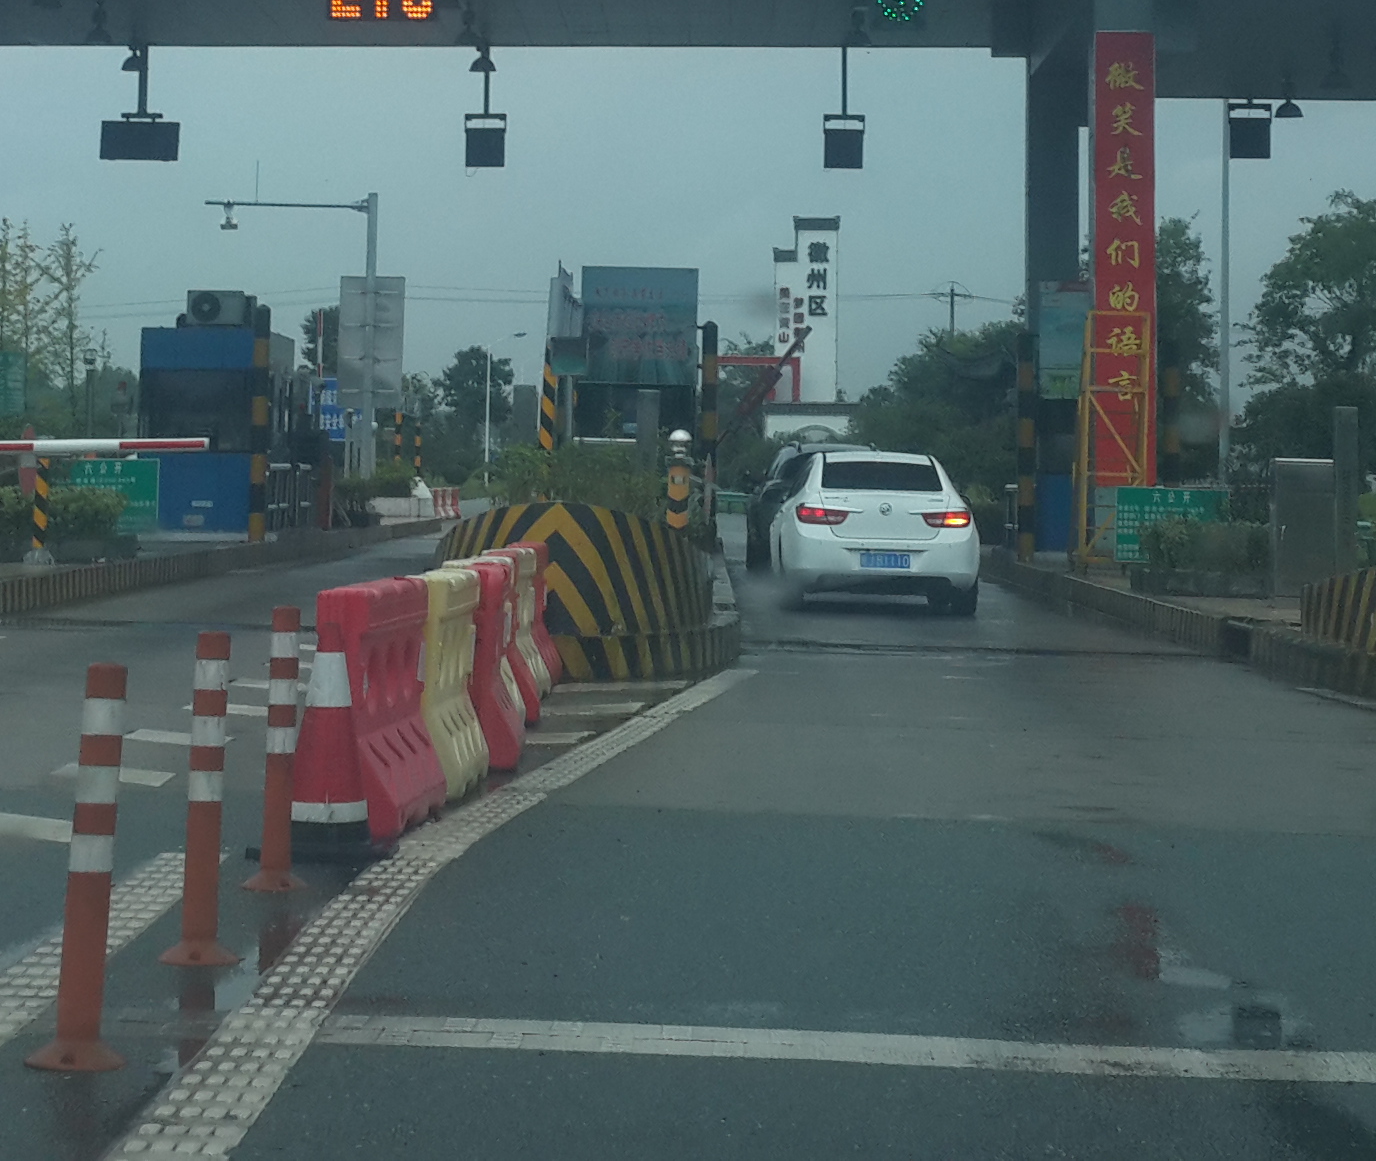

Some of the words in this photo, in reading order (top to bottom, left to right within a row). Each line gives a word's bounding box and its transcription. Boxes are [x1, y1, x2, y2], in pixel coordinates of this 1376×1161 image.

[807, 241, 830, 317] 徽州区
[1105, 61, 1145, 402] 微笑是我们的语言
